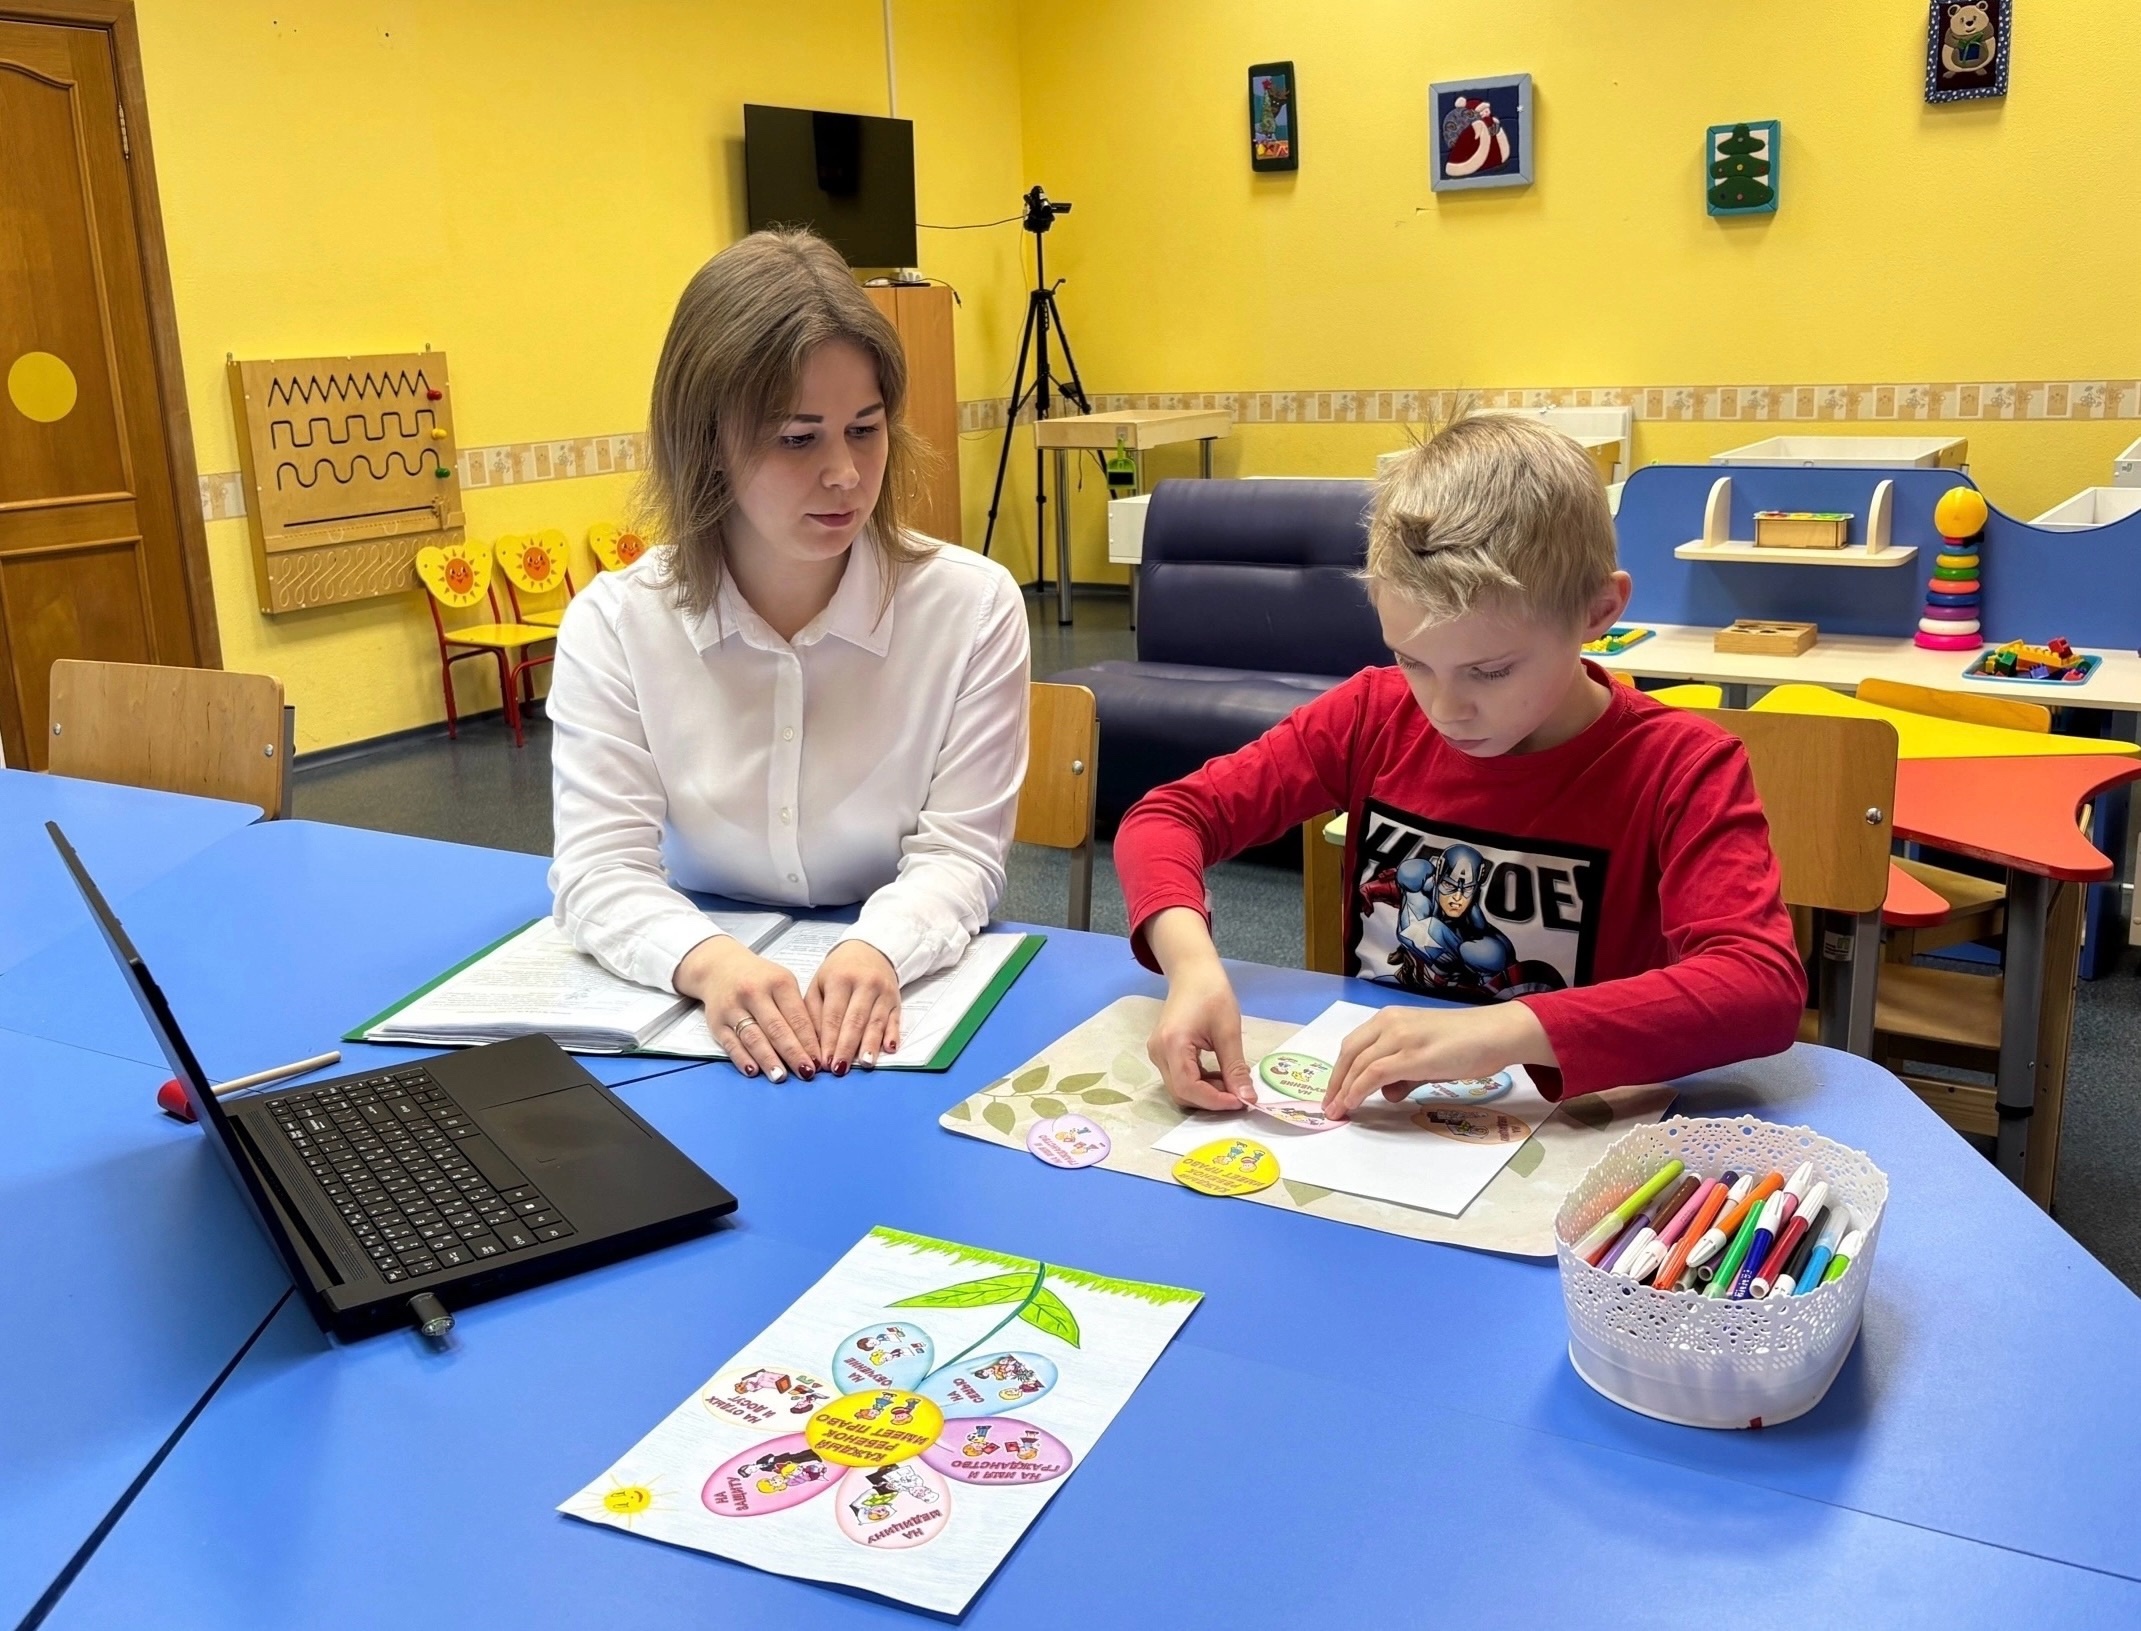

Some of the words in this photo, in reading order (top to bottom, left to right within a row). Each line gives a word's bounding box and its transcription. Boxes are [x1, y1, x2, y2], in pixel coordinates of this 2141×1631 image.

[1182, 1158, 1224, 1175] ПРАВО
[843, 1357, 893, 1387] ОБУЧЕНИЕ
[848, 1372, 865, 1383] НА
[947, 1390, 964, 1402] НА
[705, 1395, 744, 1416] ОТДЫХ
[743, 1413, 762, 1424] НА
[763, 1410, 776, 1419] И
[815, 1414, 869, 1434] ПРАВО
[822, 1429, 898, 1451] РЕБЕНОК
[871, 1427, 929, 1446] ИМЕЕТ
[815, 1438, 888, 1462] КАЖДЫЙ
[950, 1460, 1062, 1473] ГРАЖДАНСТВО
[967, 1470, 979, 1479] И
[1021, 1471, 1042, 1480] НА
[713, 1490, 729, 1505] НА
[866, 1508, 944, 1545] МЕДИЦИНУ
[901, 1527, 925, 1540] НА
